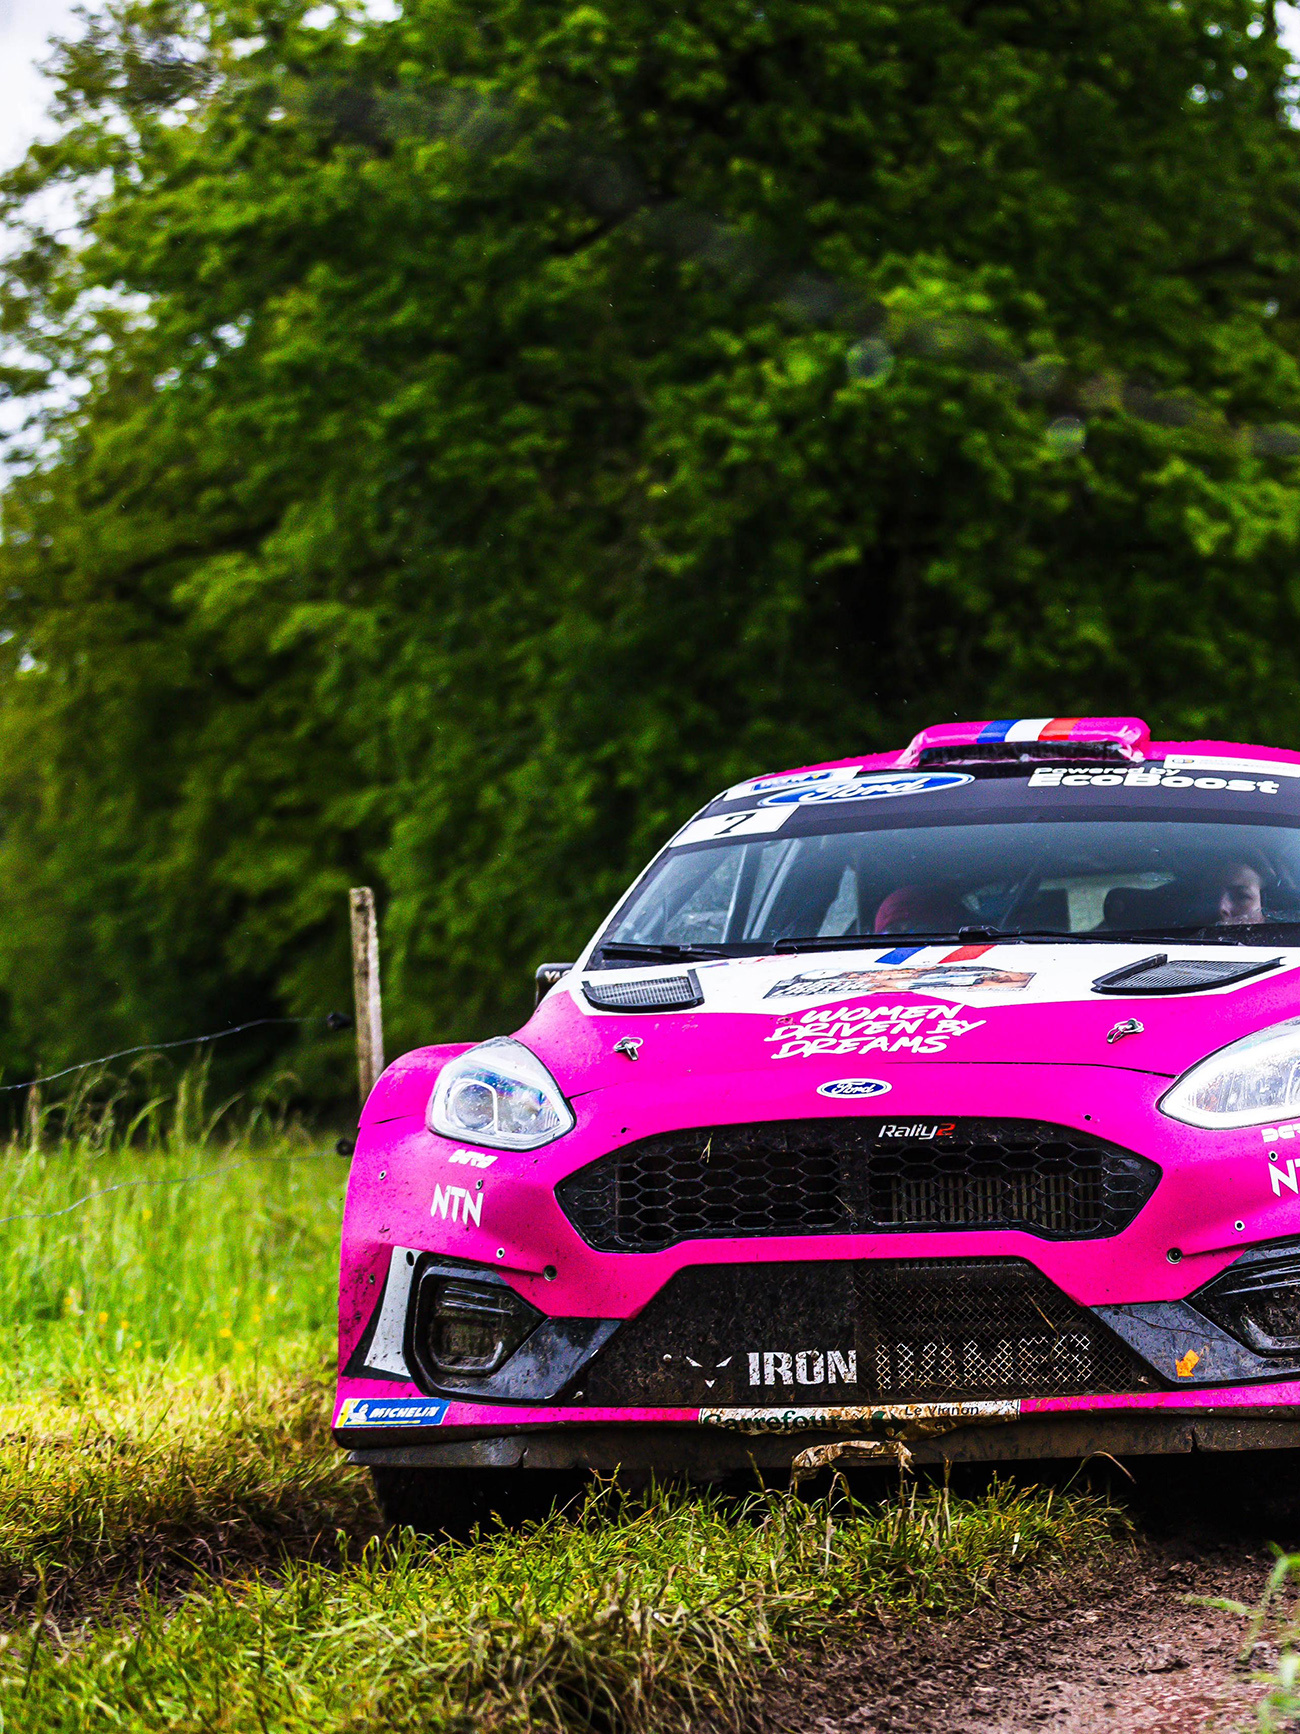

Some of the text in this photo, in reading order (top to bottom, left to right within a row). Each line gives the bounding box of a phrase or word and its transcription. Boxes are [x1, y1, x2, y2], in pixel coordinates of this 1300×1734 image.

[1033, 767, 1181, 777] Powered by
[799, 777, 932, 802] Ford
[1028, 773, 1280, 794] EcoBoost
[800, 1004, 967, 1024] WOMEN
[764, 1019, 987, 1042] DRIVEN BY
[770, 1035, 950, 1059] DREAMS
[832, 1081, 876, 1095] Ford
[878, 1123, 956, 1140] Rally2
[430, 1183, 485, 1228] NTN
[747, 1350, 858, 1387] IRON
[368, 1406, 441, 1419] MICHELIN
[702, 1410, 842, 1431] Carrefour
[905, 1404, 923, 1417] Le
